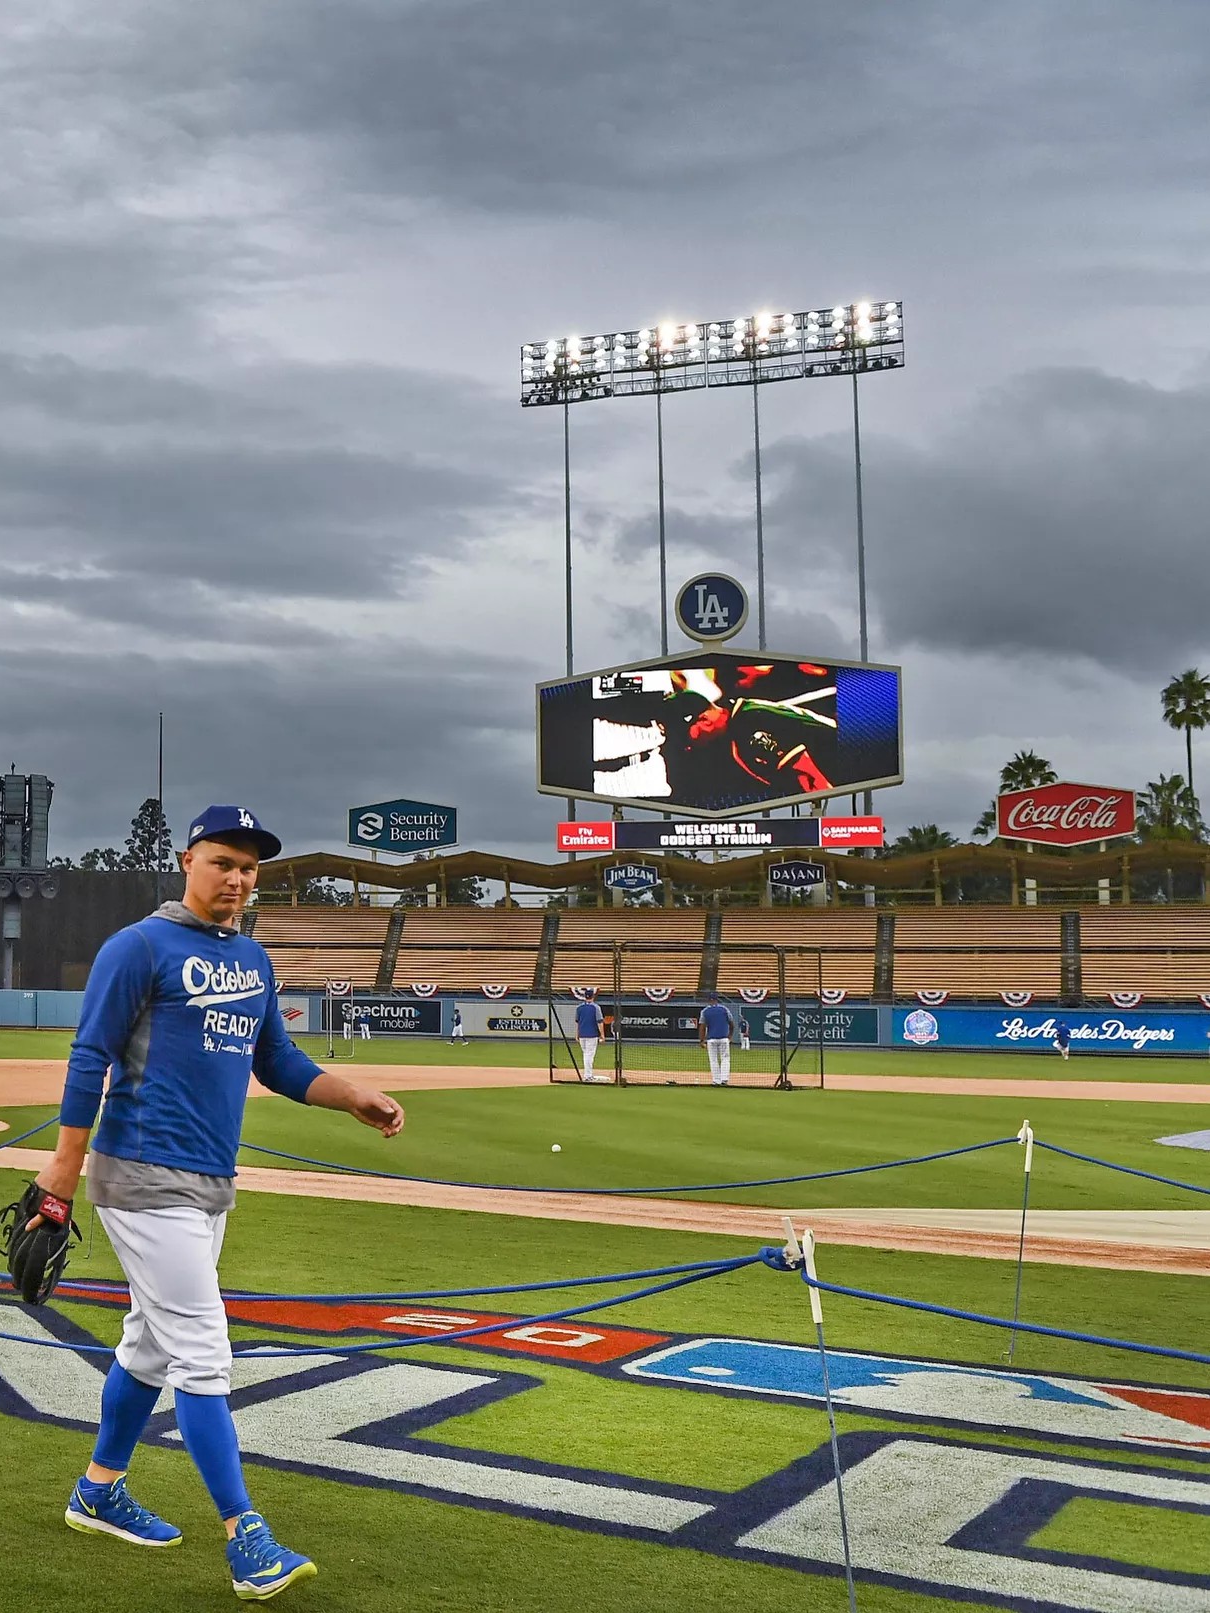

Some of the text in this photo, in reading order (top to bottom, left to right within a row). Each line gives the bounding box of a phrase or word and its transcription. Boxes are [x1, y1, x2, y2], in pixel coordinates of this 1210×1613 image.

[694, 585, 729, 628] LA
[237, 808, 254, 829] LA
[389, 811, 448, 828] Security
[1007, 795, 1123, 831] Coca-Cola
[389, 827, 440, 840] Benefit
[578, 827, 593, 836] Fly
[674, 823, 756, 835] WELCOME TO
[562, 834, 609, 845] Emirates
[660, 833, 772, 846] DODGER STADIUM
[607, 869, 626, 885] JIM
[627, 866, 654, 884] BEAM
[772, 867, 821, 881] DASANI
[182, 955, 265, 998] October
[203, 1009, 259, 1039] READY
[380, 1019, 415, 1029] mobile
[995, 1017, 1175, 1049] Los Aneles Dodgers
